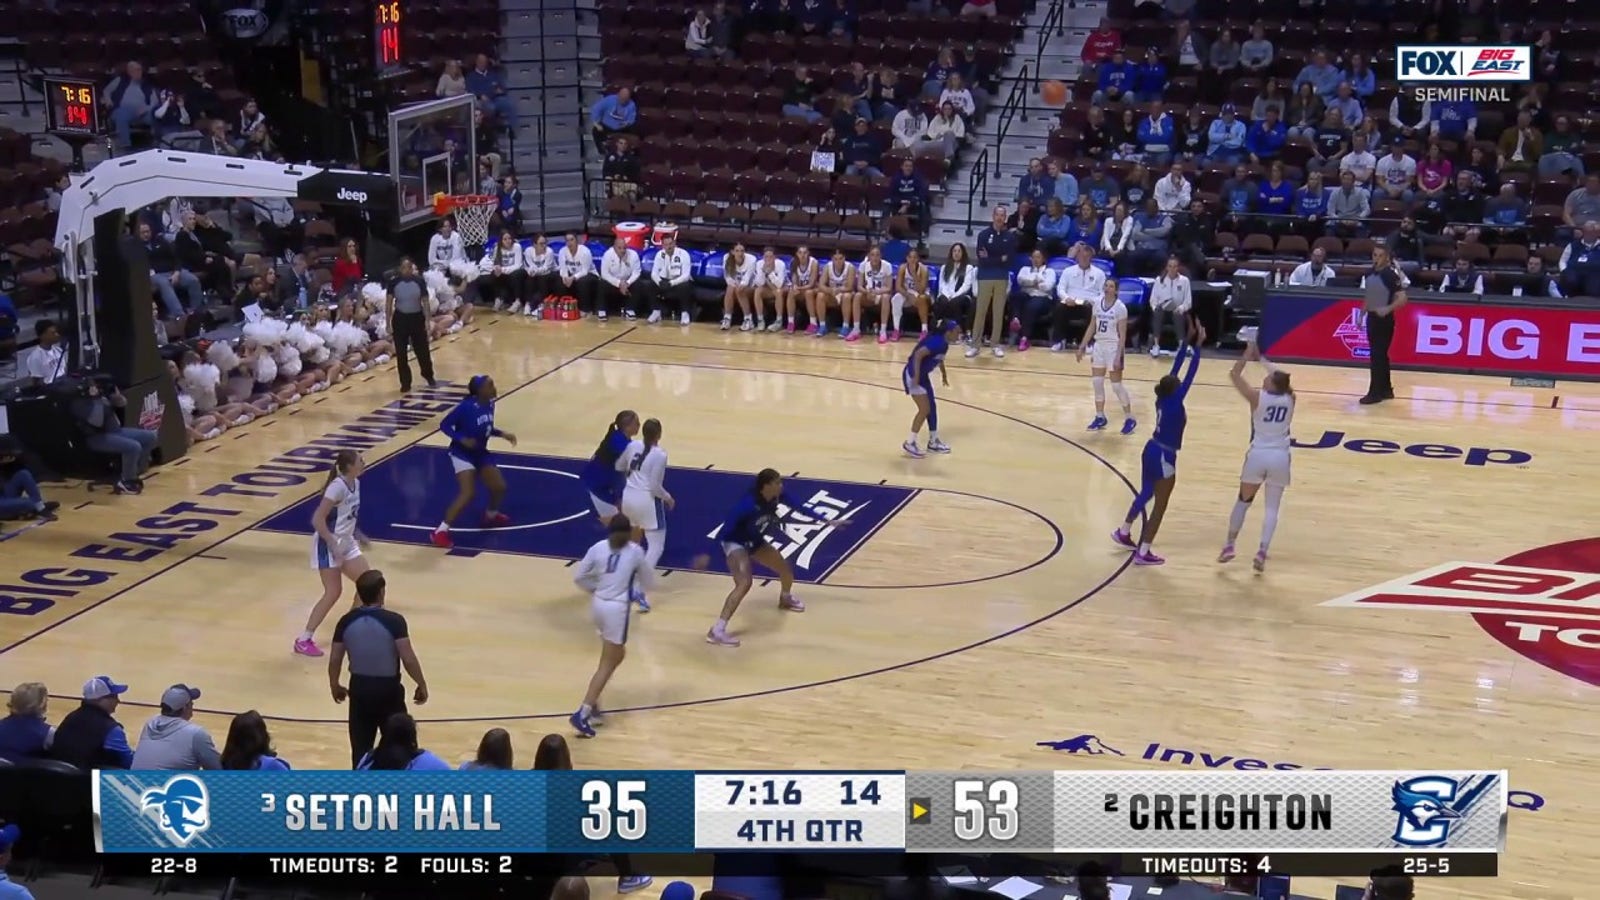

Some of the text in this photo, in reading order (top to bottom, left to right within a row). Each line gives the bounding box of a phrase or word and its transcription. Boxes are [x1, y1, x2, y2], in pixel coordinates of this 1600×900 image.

[379, 2, 400, 23] 7:16
[382, 26, 398, 63] 14
[61, 86, 91, 105] 7:16
[67, 105, 87, 125] 14
[337, 187, 368, 204] Jeep
[1098, 320, 1109, 333] 15
[1415, 314, 1540, 361] BIG
[1263, 405, 1289, 423] 30
[1289, 430, 1532, 466] Jeep
[0, 567, 119, 616] BIG
[69, 501, 243, 562] EAST
